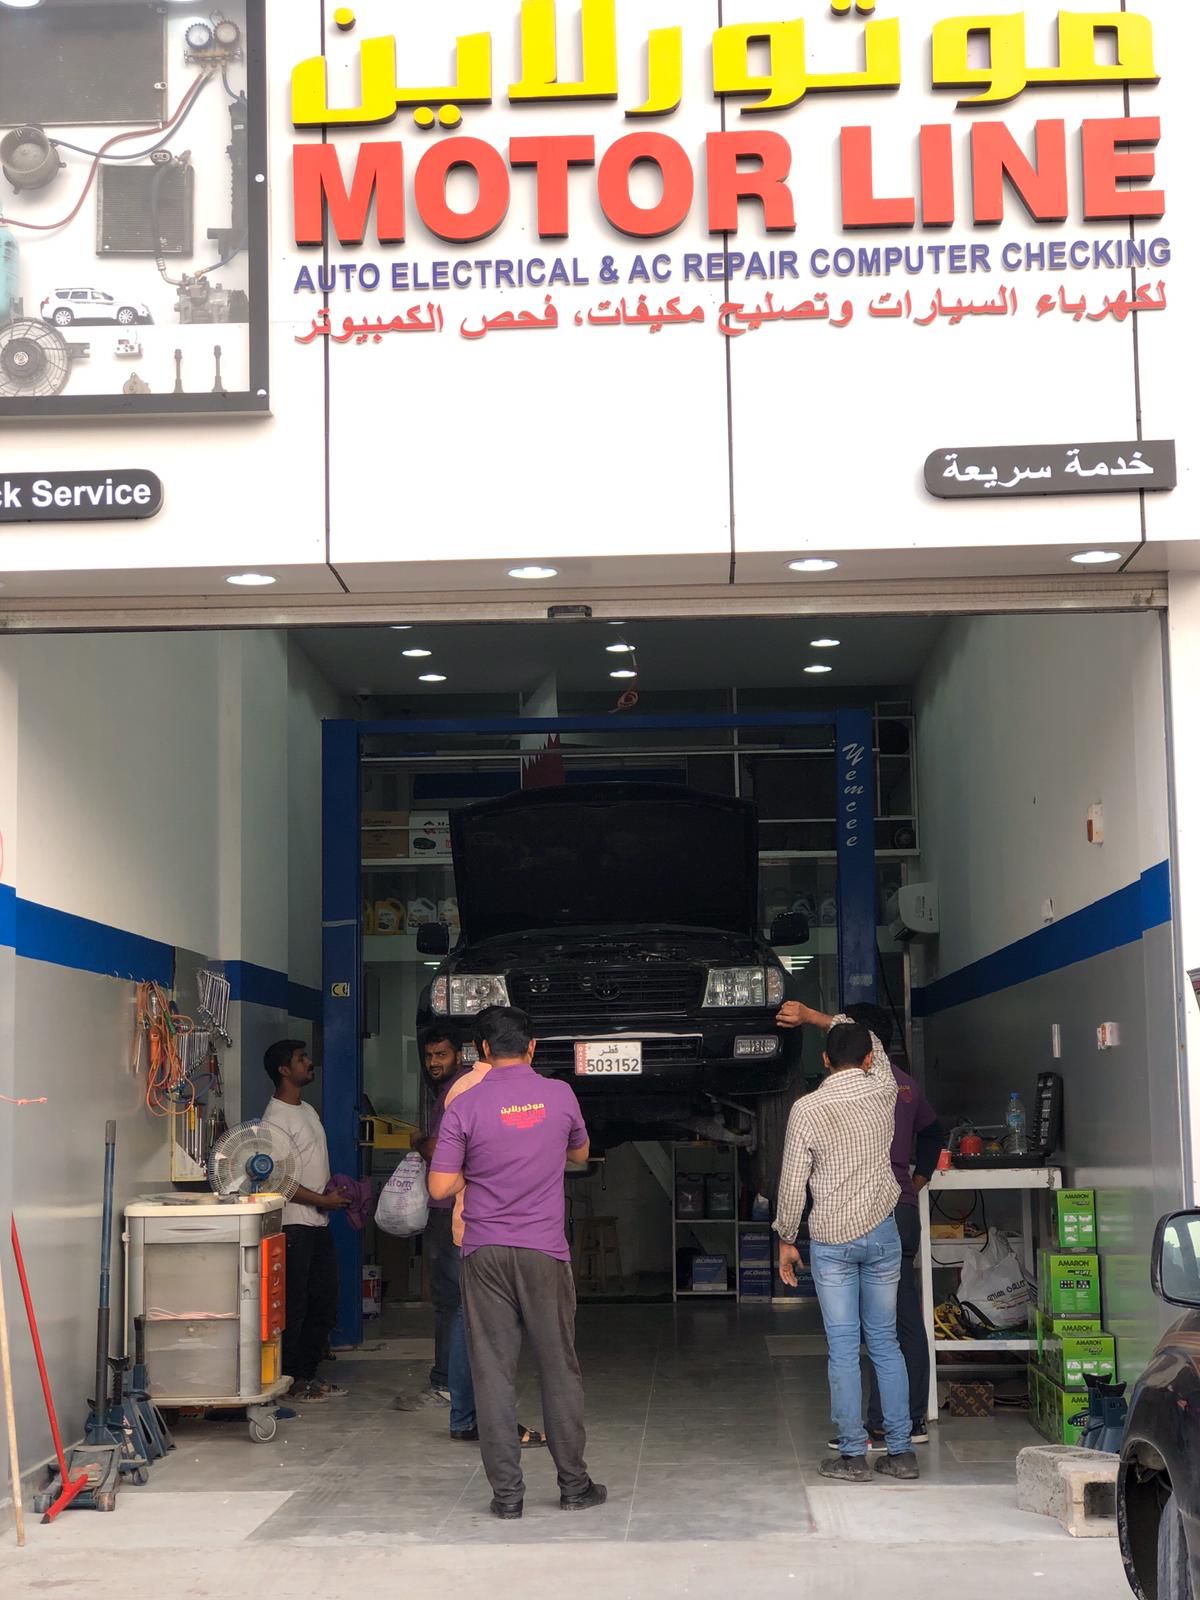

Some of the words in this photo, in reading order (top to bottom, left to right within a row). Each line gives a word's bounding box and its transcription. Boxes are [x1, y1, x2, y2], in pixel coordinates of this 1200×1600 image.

[292, 129, 796, 246] MOTOR
[839, 115, 1165, 230] LINE
[294, 263, 380, 292] AUTO
[391, 257, 590, 290] ELECTRICAL
[599, 256, 619, 282] &
[629, 254, 673, 281] AC
[684, 250, 799, 280] REPAIR
[809, 244, 991, 277] COMPUTER
[1001, 237, 1172, 270] CHECKING
[459, 294, 559, 339] فحص
[717, 290, 855, 337] وتصليح
[867, 285, 1018, 326] السيارات
[1036, 280, 1168, 322] لكهرباء
[294, 302, 445, 345] الكمبيوتر
[942, 452, 1053, 489] سريعة
[1064, 448, 1155, 478] خدمة
[0, 481, 22, 508] k
[31, 477, 152, 508] Service
[587, 1058, 640, 1073] 503152
[1057, 1259, 1090, 1267] AMARON
[1061, 1324, 1093, 1332] AMARON
